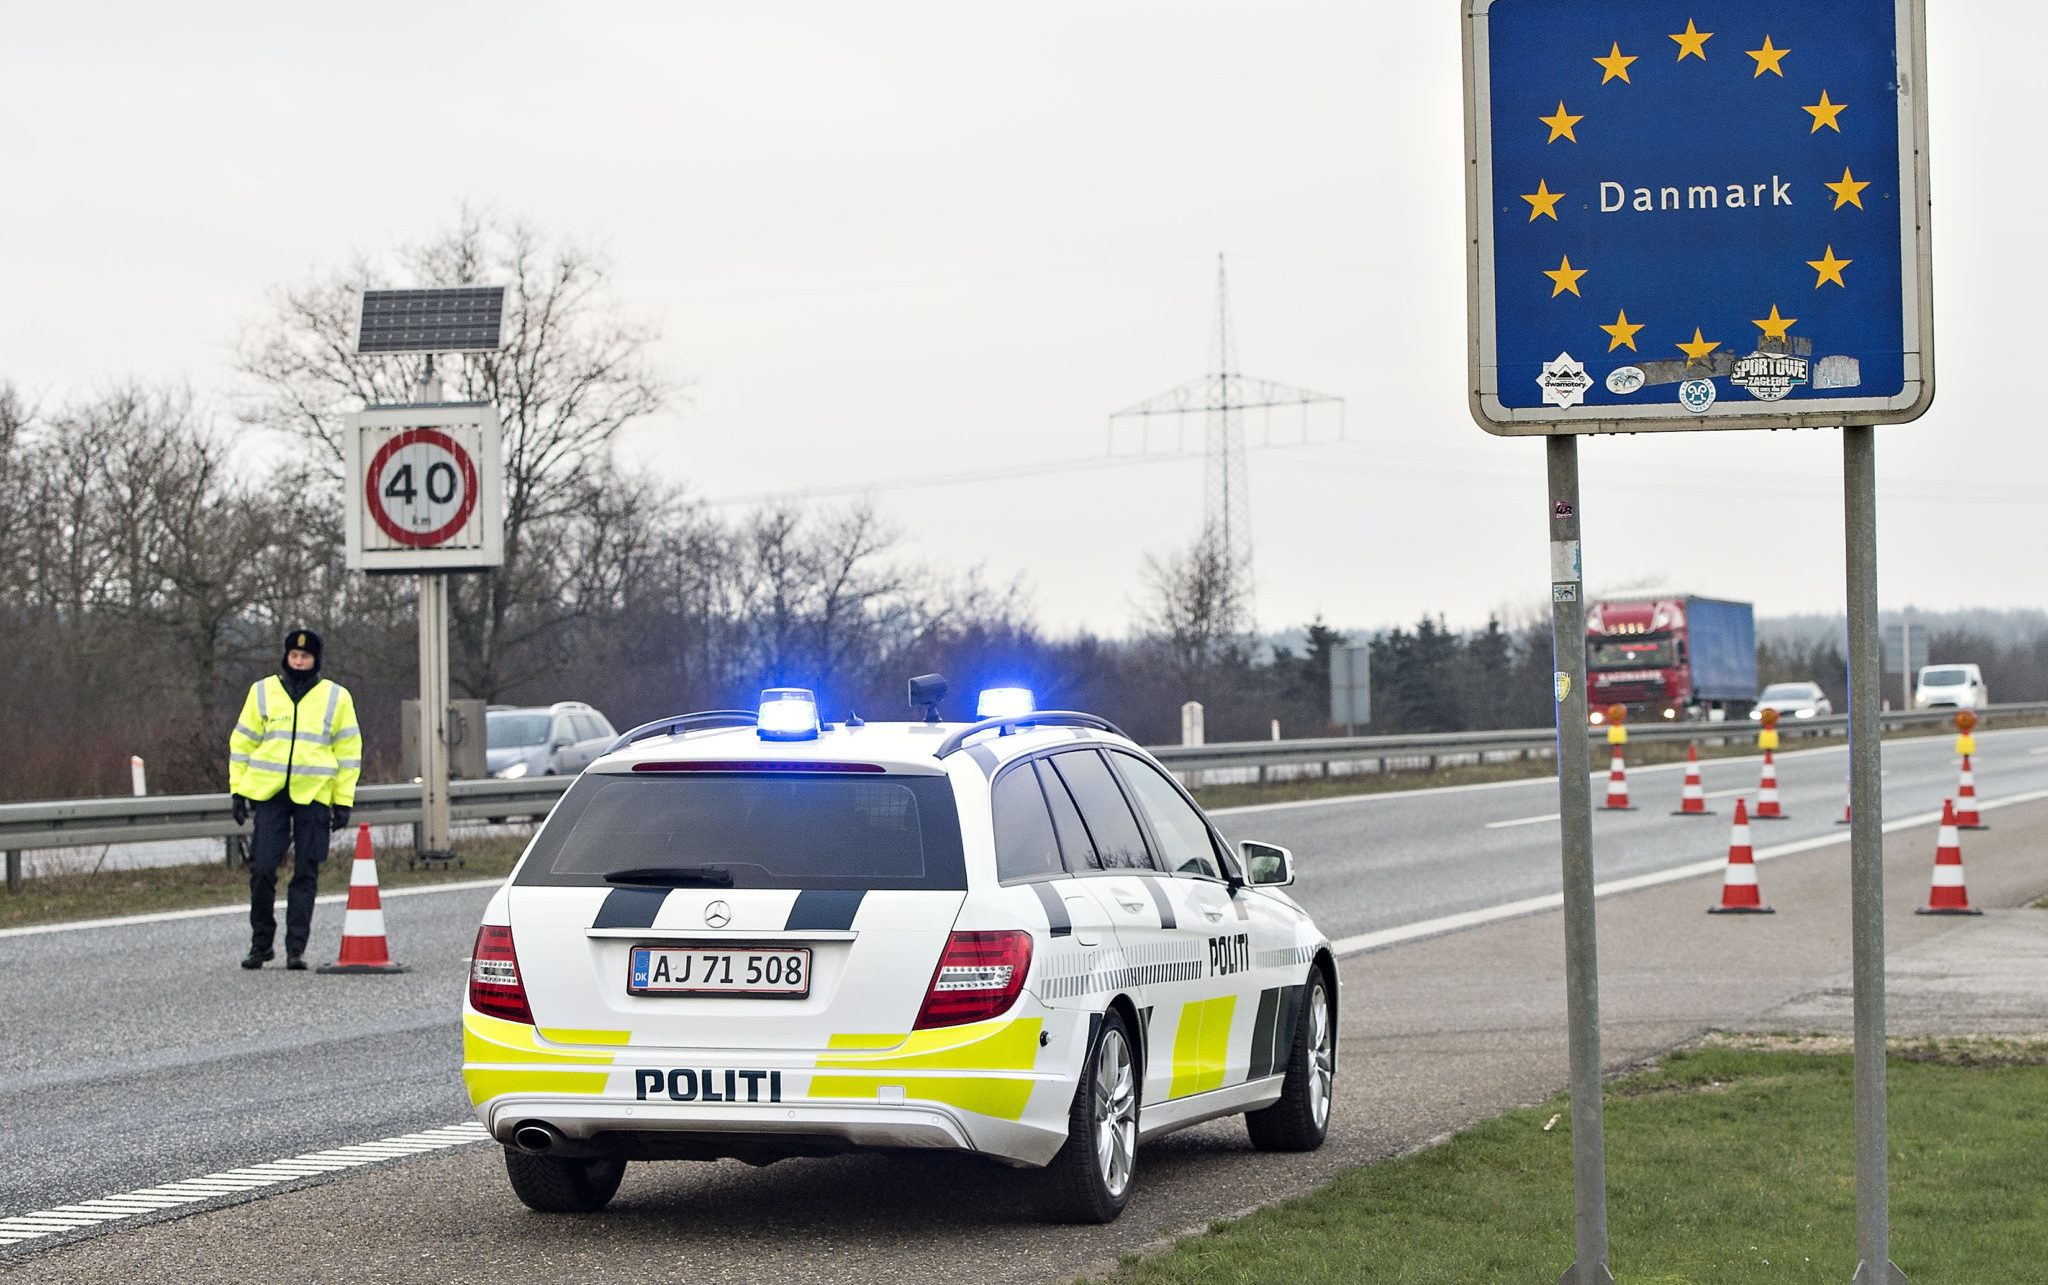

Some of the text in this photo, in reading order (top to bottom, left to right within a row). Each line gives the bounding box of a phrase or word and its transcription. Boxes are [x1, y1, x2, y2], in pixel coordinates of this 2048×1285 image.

[1600, 175, 1792, 212] Danmark
[1732, 358, 1806, 379] SPORTOWE
[1545, 381, 1586, 389] dwamotory
[385, 462, 458, 505] 40
[412, 514, 432, 526] km
[652, 955, 802, 985] AJ 71 508
[1208, 933, 1250, 977] POLITI
[635, 972, 647, 982] DK
[635, 1068, 782, 1103] POLITI
